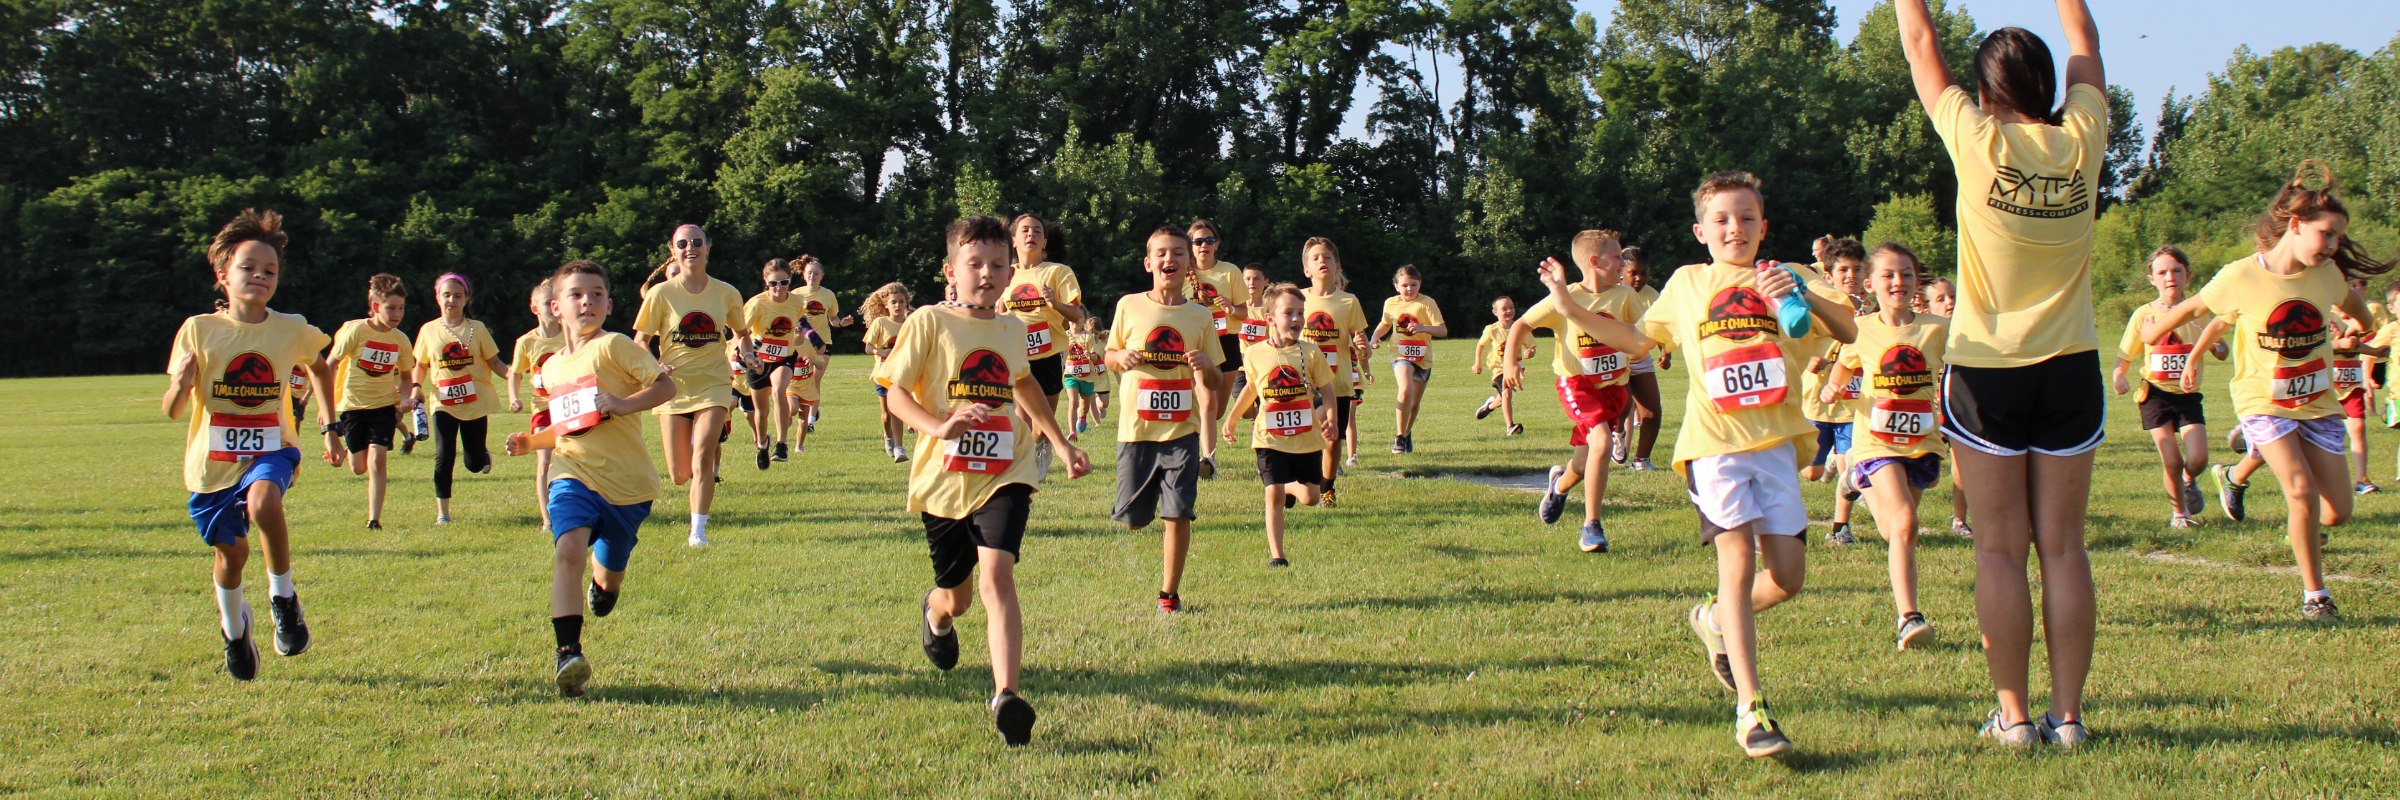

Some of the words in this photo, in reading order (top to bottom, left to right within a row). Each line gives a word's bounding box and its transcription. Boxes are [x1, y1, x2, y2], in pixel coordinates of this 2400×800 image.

[1989, 198, 2036, 216] FITNESS
[2042, 203, 2088, 218] COMPANY
[1246, 324, 1257, 335] 94
[1026, 331, 1043, 348] 94
[370, 350, 392, 364] 413
[765, 344, 783, 356] 407
[1404, 345, 1421, 356] 366
[1592, 354, 1618, 373] 759
[2161, 354, 2186, 371] 853
[1722, 361, 1769, 394] 664
[2337, 368, 2357, 381] 796
[239, 385, 280, 397] CHALLENGE
[447, 383, 468, 398] 430
[2286, 372, 2316, 397] 427
[561, 392, 581, 419] 95
[1150, 390, 1181, 410] 660
[1276, 410, 1302, 428] 913
[1885, 412, 1920, 434] 426
[225, 427, 264, 451] 925
[958, 430, 999, 458] 662
